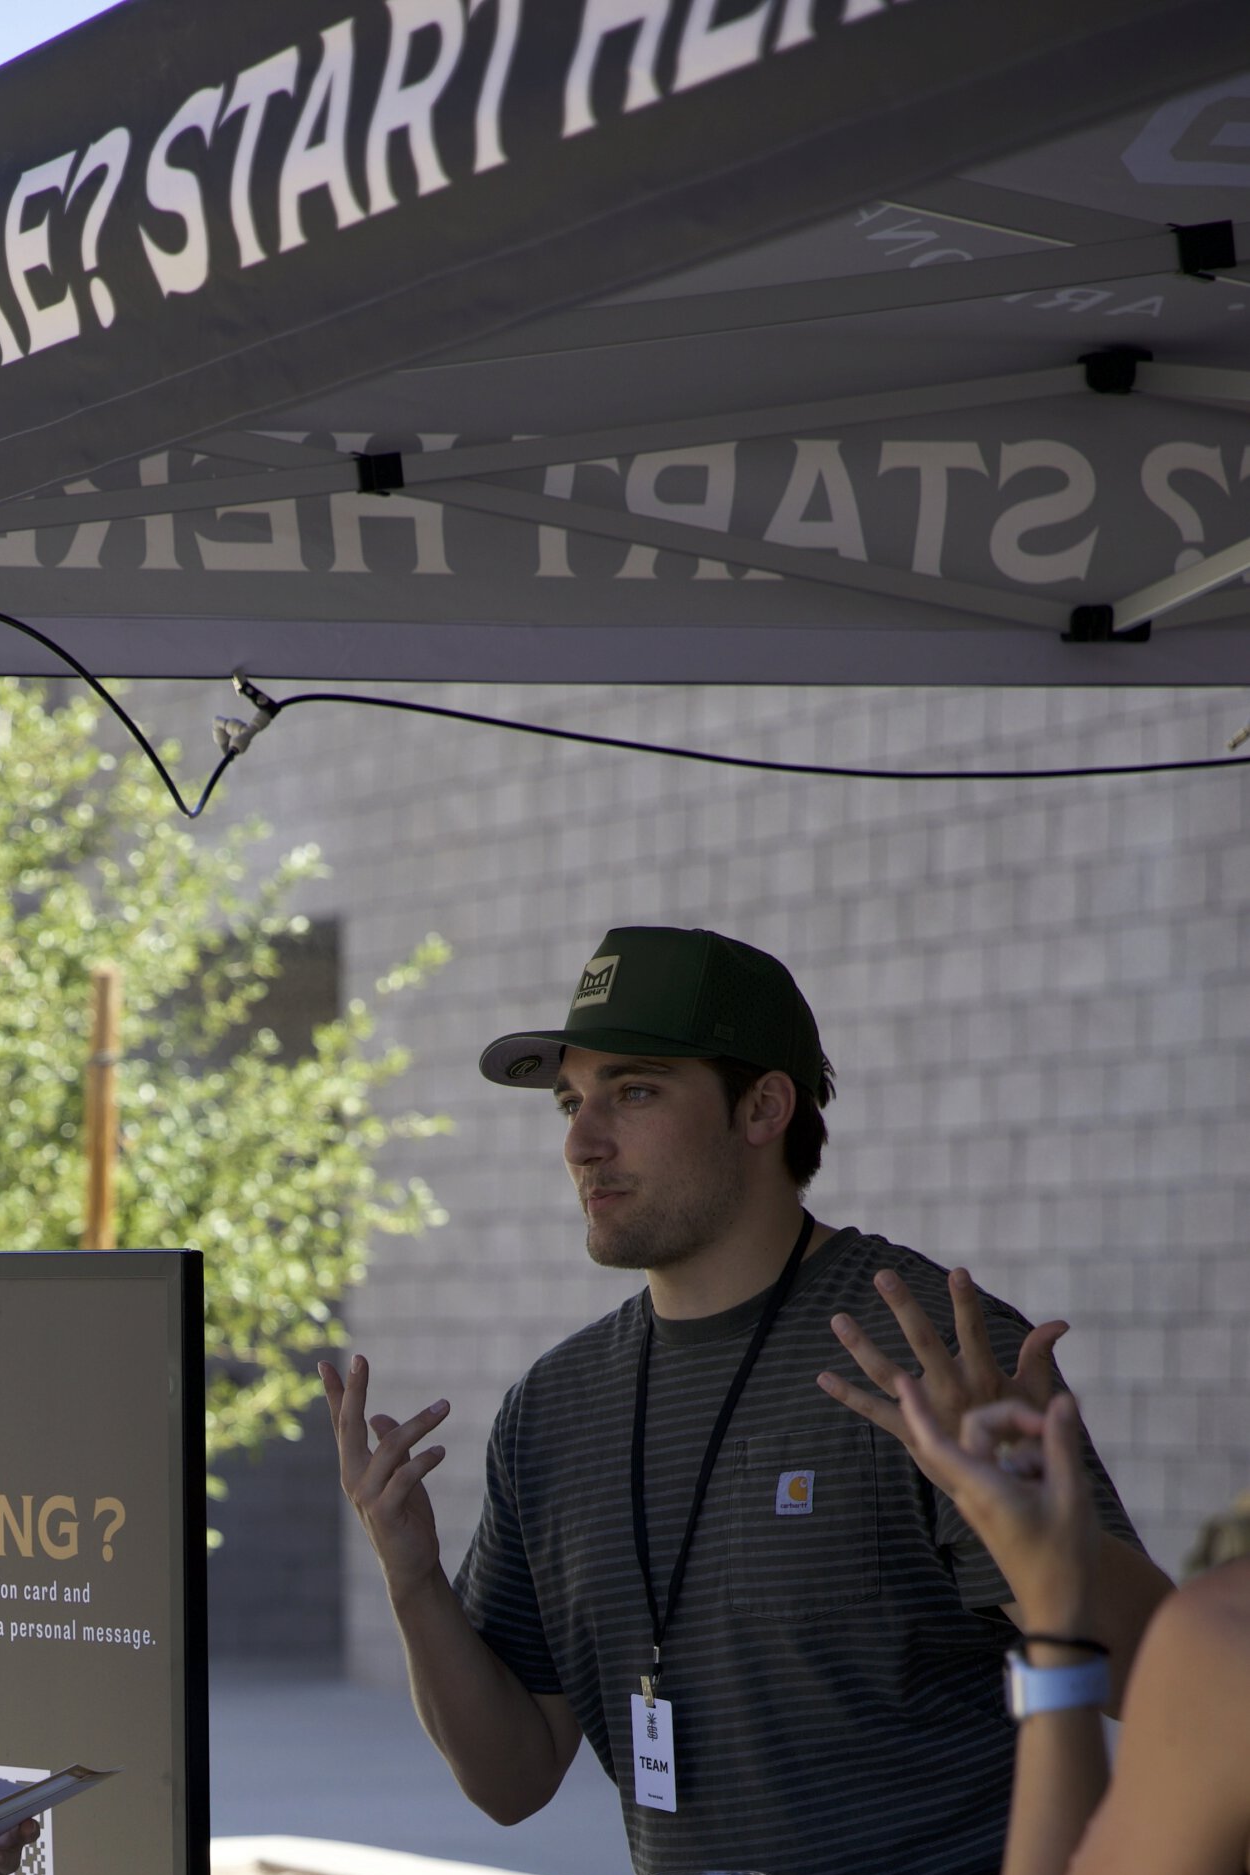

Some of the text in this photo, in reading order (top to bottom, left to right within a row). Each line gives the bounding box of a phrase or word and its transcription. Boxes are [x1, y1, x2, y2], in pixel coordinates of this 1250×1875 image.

[577, 987, 607, 1000] melin
[23, 1580, 57, 1601] card
[63, 1582, 90, 1603] and
[10, 1619, 76, 1642] personal
[82, 1625, 156, 1650] message.
[639, 1755, 669, 1774] TEAM
